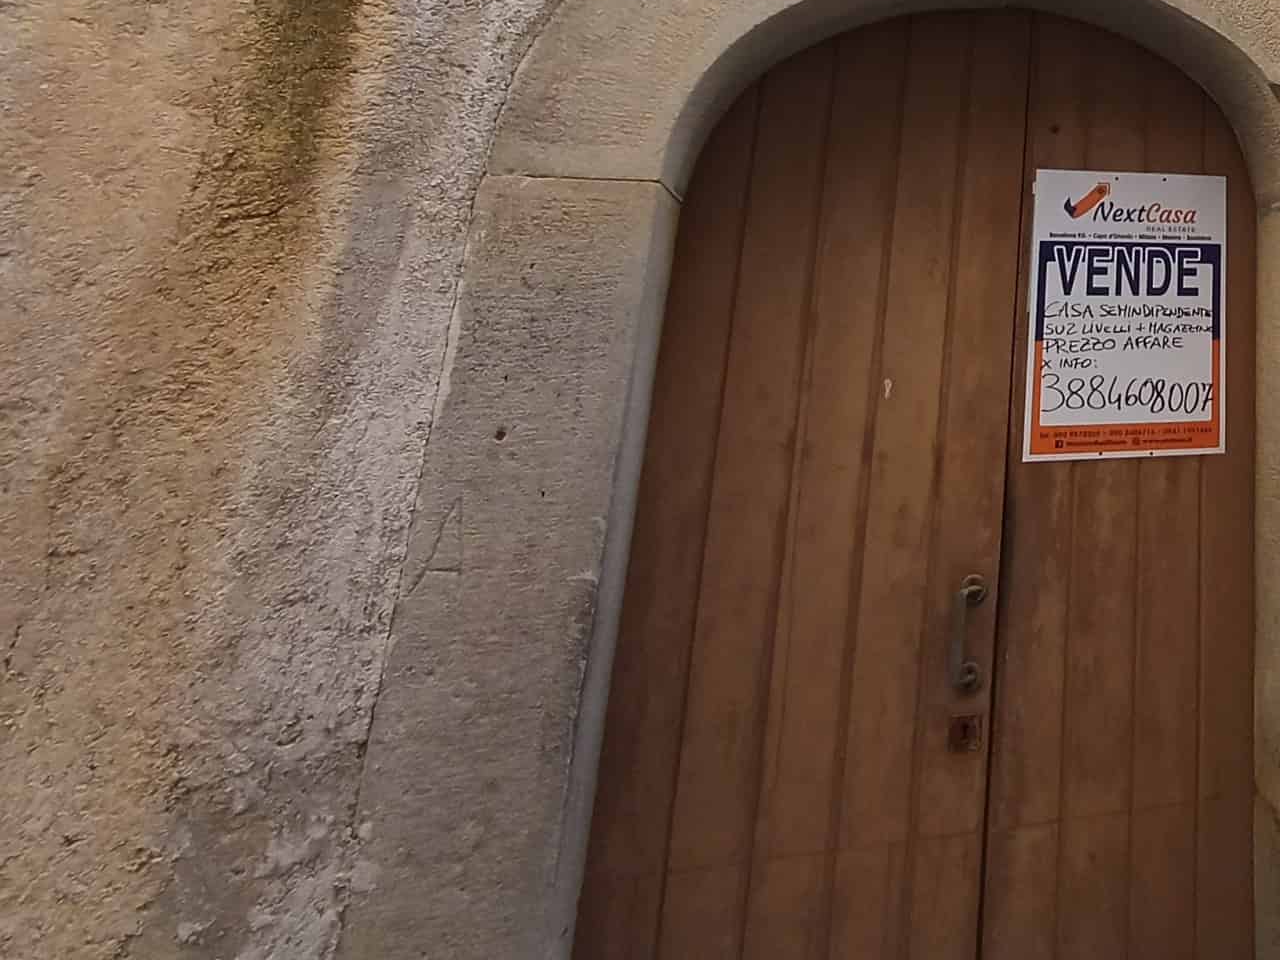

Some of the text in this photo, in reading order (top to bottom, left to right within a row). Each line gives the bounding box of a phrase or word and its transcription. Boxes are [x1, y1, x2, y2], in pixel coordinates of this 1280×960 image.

[1092, 201, 1197, 223] NextCasa
[1054, 246, 1201, 297] VENDE
[1043, 301, 1094, 319] CASA
[1043, 336, 1185, 353] PREZZO AFFARE
[1059, 358, 1098, 369] INFO:
[1041, 373, 1213, 414] 3884608007
